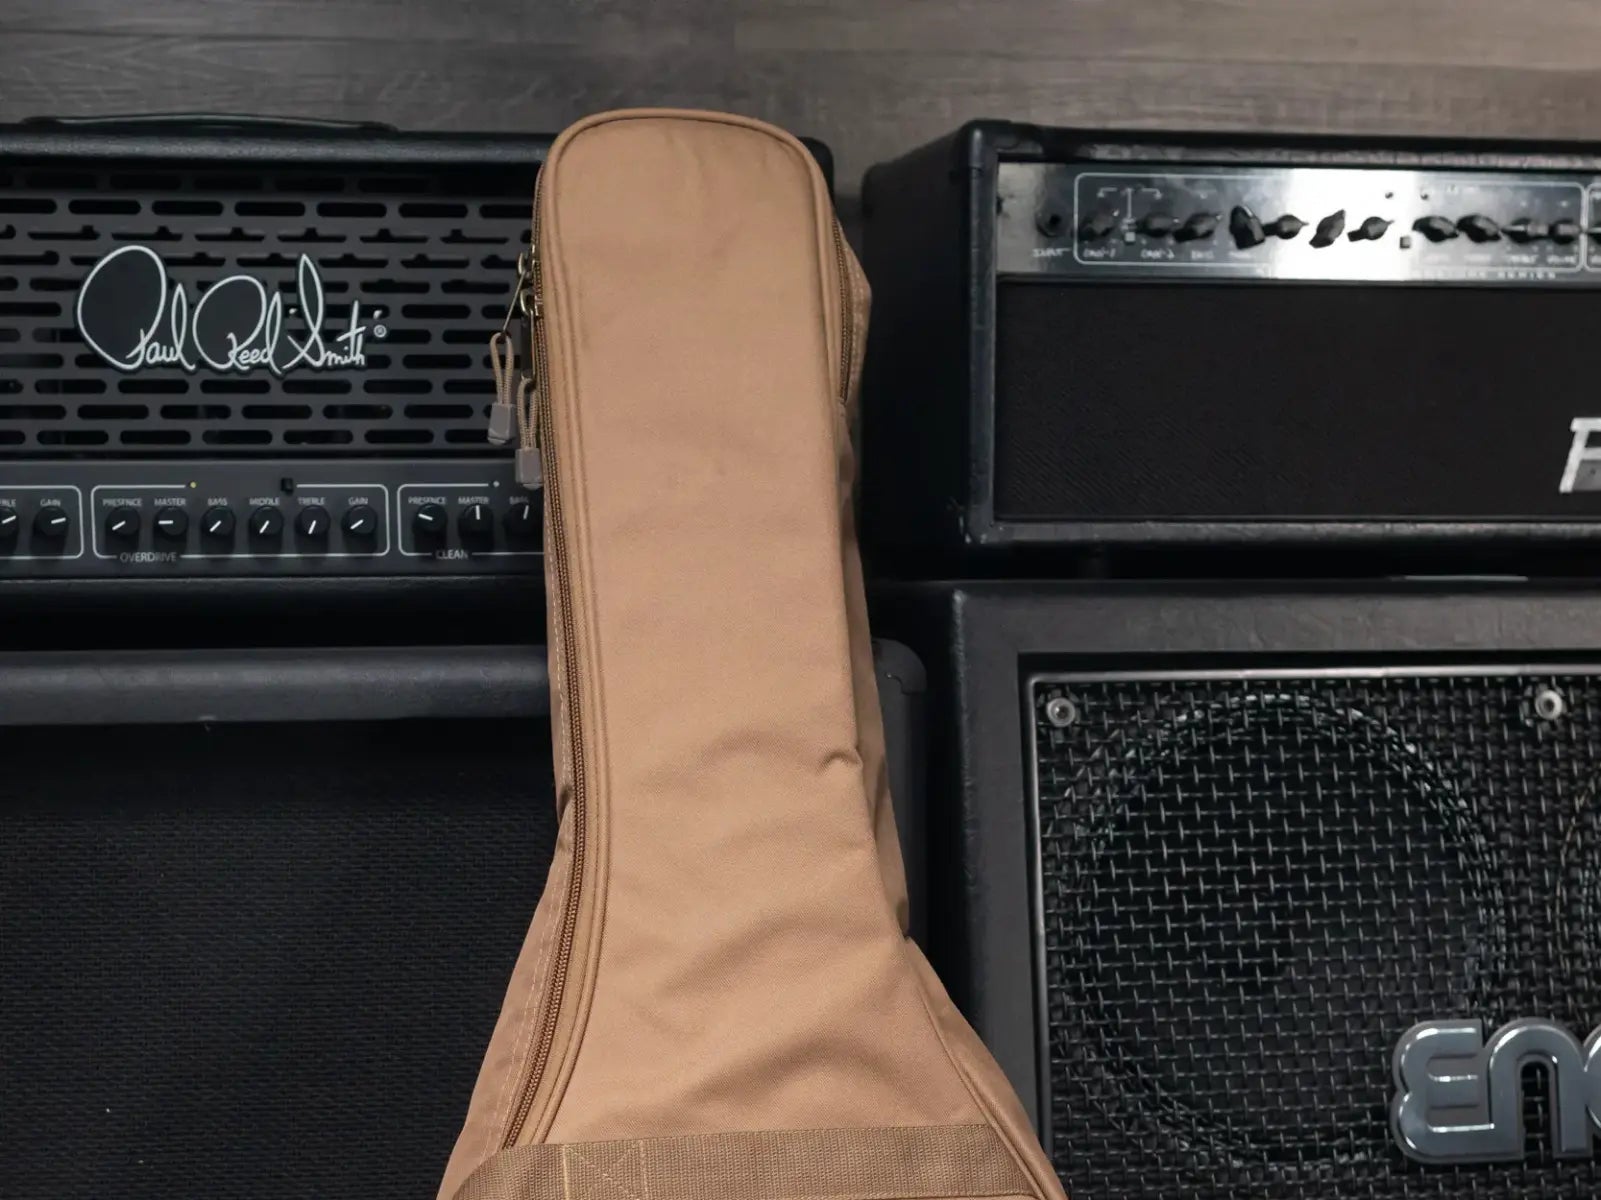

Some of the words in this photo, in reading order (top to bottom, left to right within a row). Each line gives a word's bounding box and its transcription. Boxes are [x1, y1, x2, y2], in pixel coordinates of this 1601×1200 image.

[77, 245, 195, 370] Paul
[192, 275, 283, 374] Reed
[281, 253, 367, 369] Smith
[153, 497, 187, 507] MASTER
[458, 496, 490, 505] MASTER
[119, 552, 177, 563] OVERDRIVE
[436, 548, 469, 560] CLEAN
